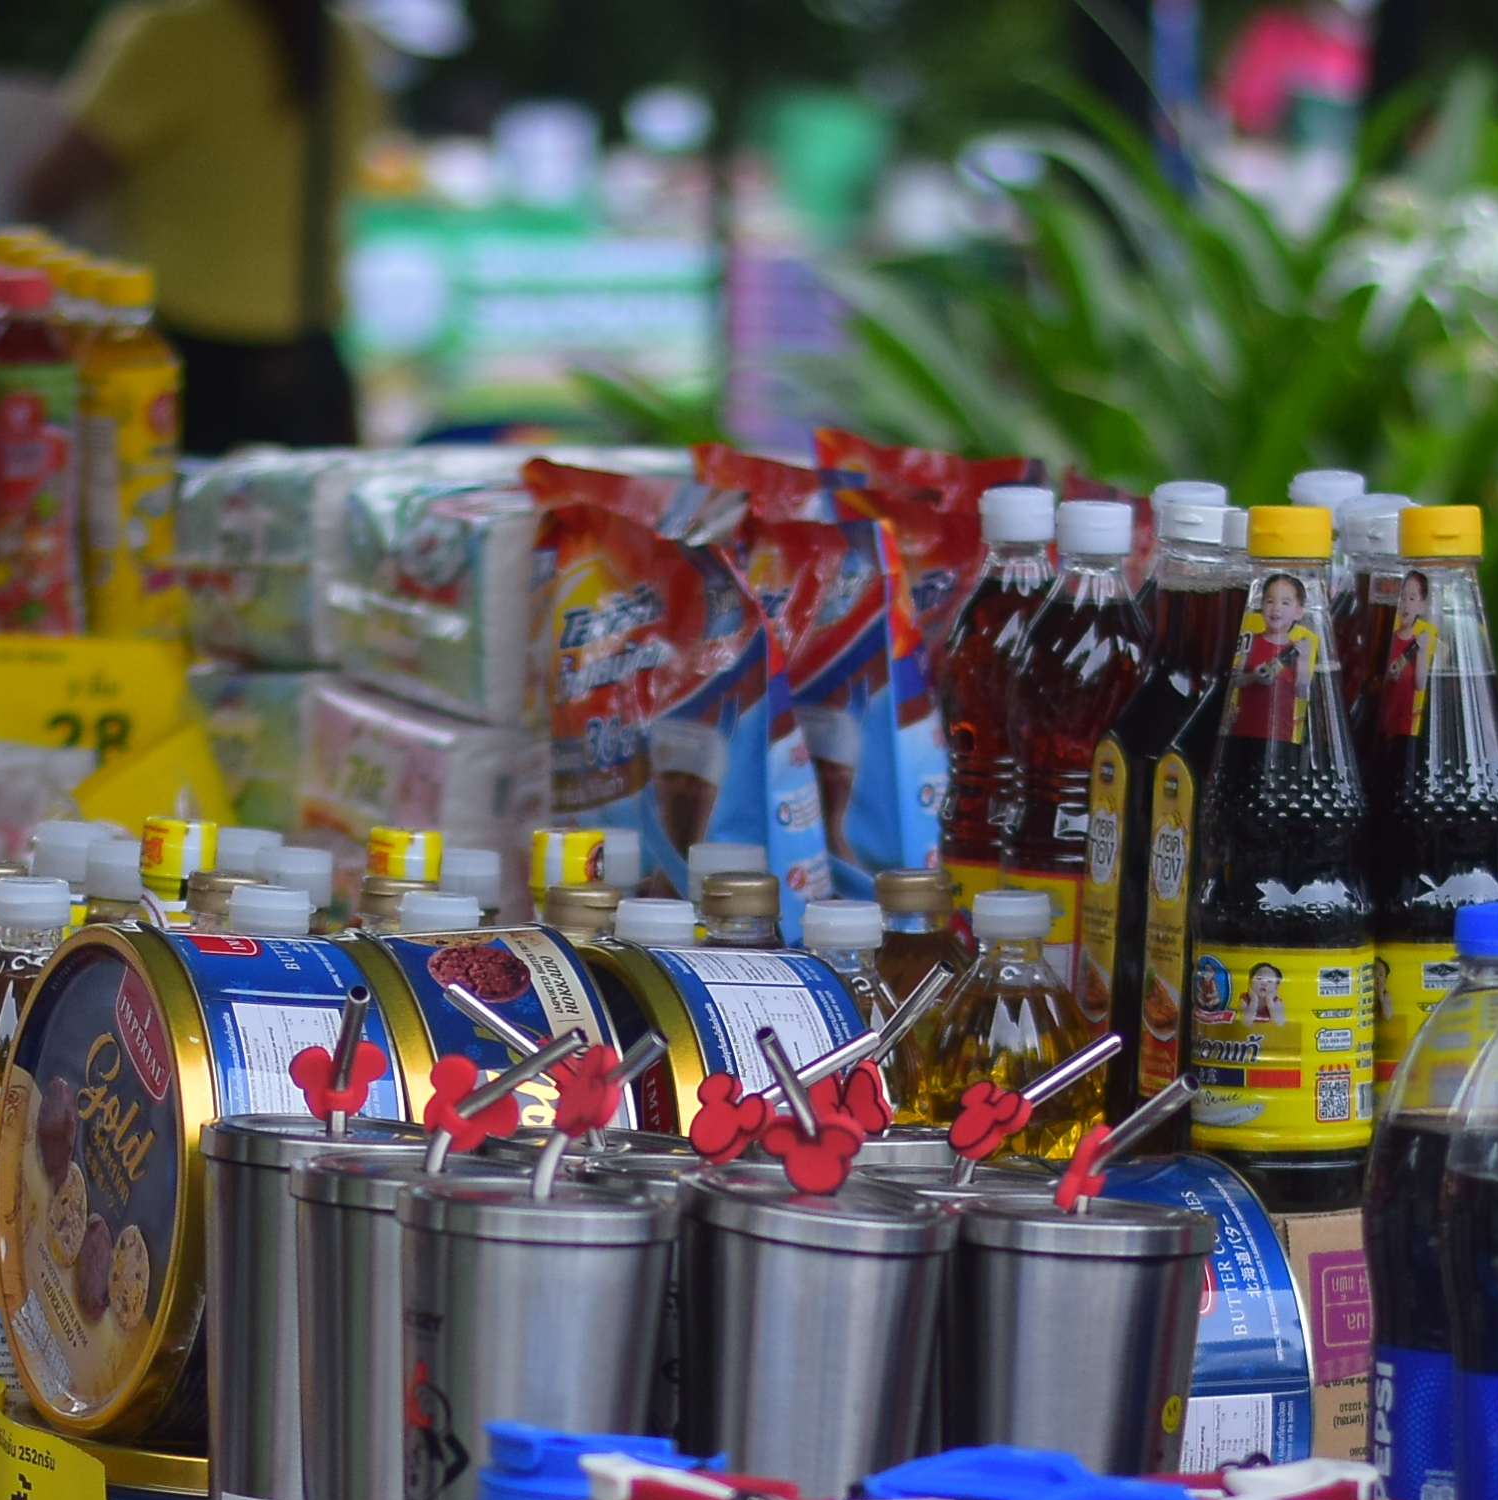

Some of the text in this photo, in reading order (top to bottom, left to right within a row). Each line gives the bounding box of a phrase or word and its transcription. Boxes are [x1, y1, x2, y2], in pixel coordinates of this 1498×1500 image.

[539, 955, 581, 1015] HOKKAIDO
[118, 995, 166, 1089] IMPERIAL
[76, 1031, 156, 1184] Gold
[43, 1275, 75, 1345] HOKKAIDO
[1217, 1259, 1248, 1336] BUTTER
[1339, 1402, 1362, 1412] 10310
[18, 1445, 57, 1471] 252กรัม
